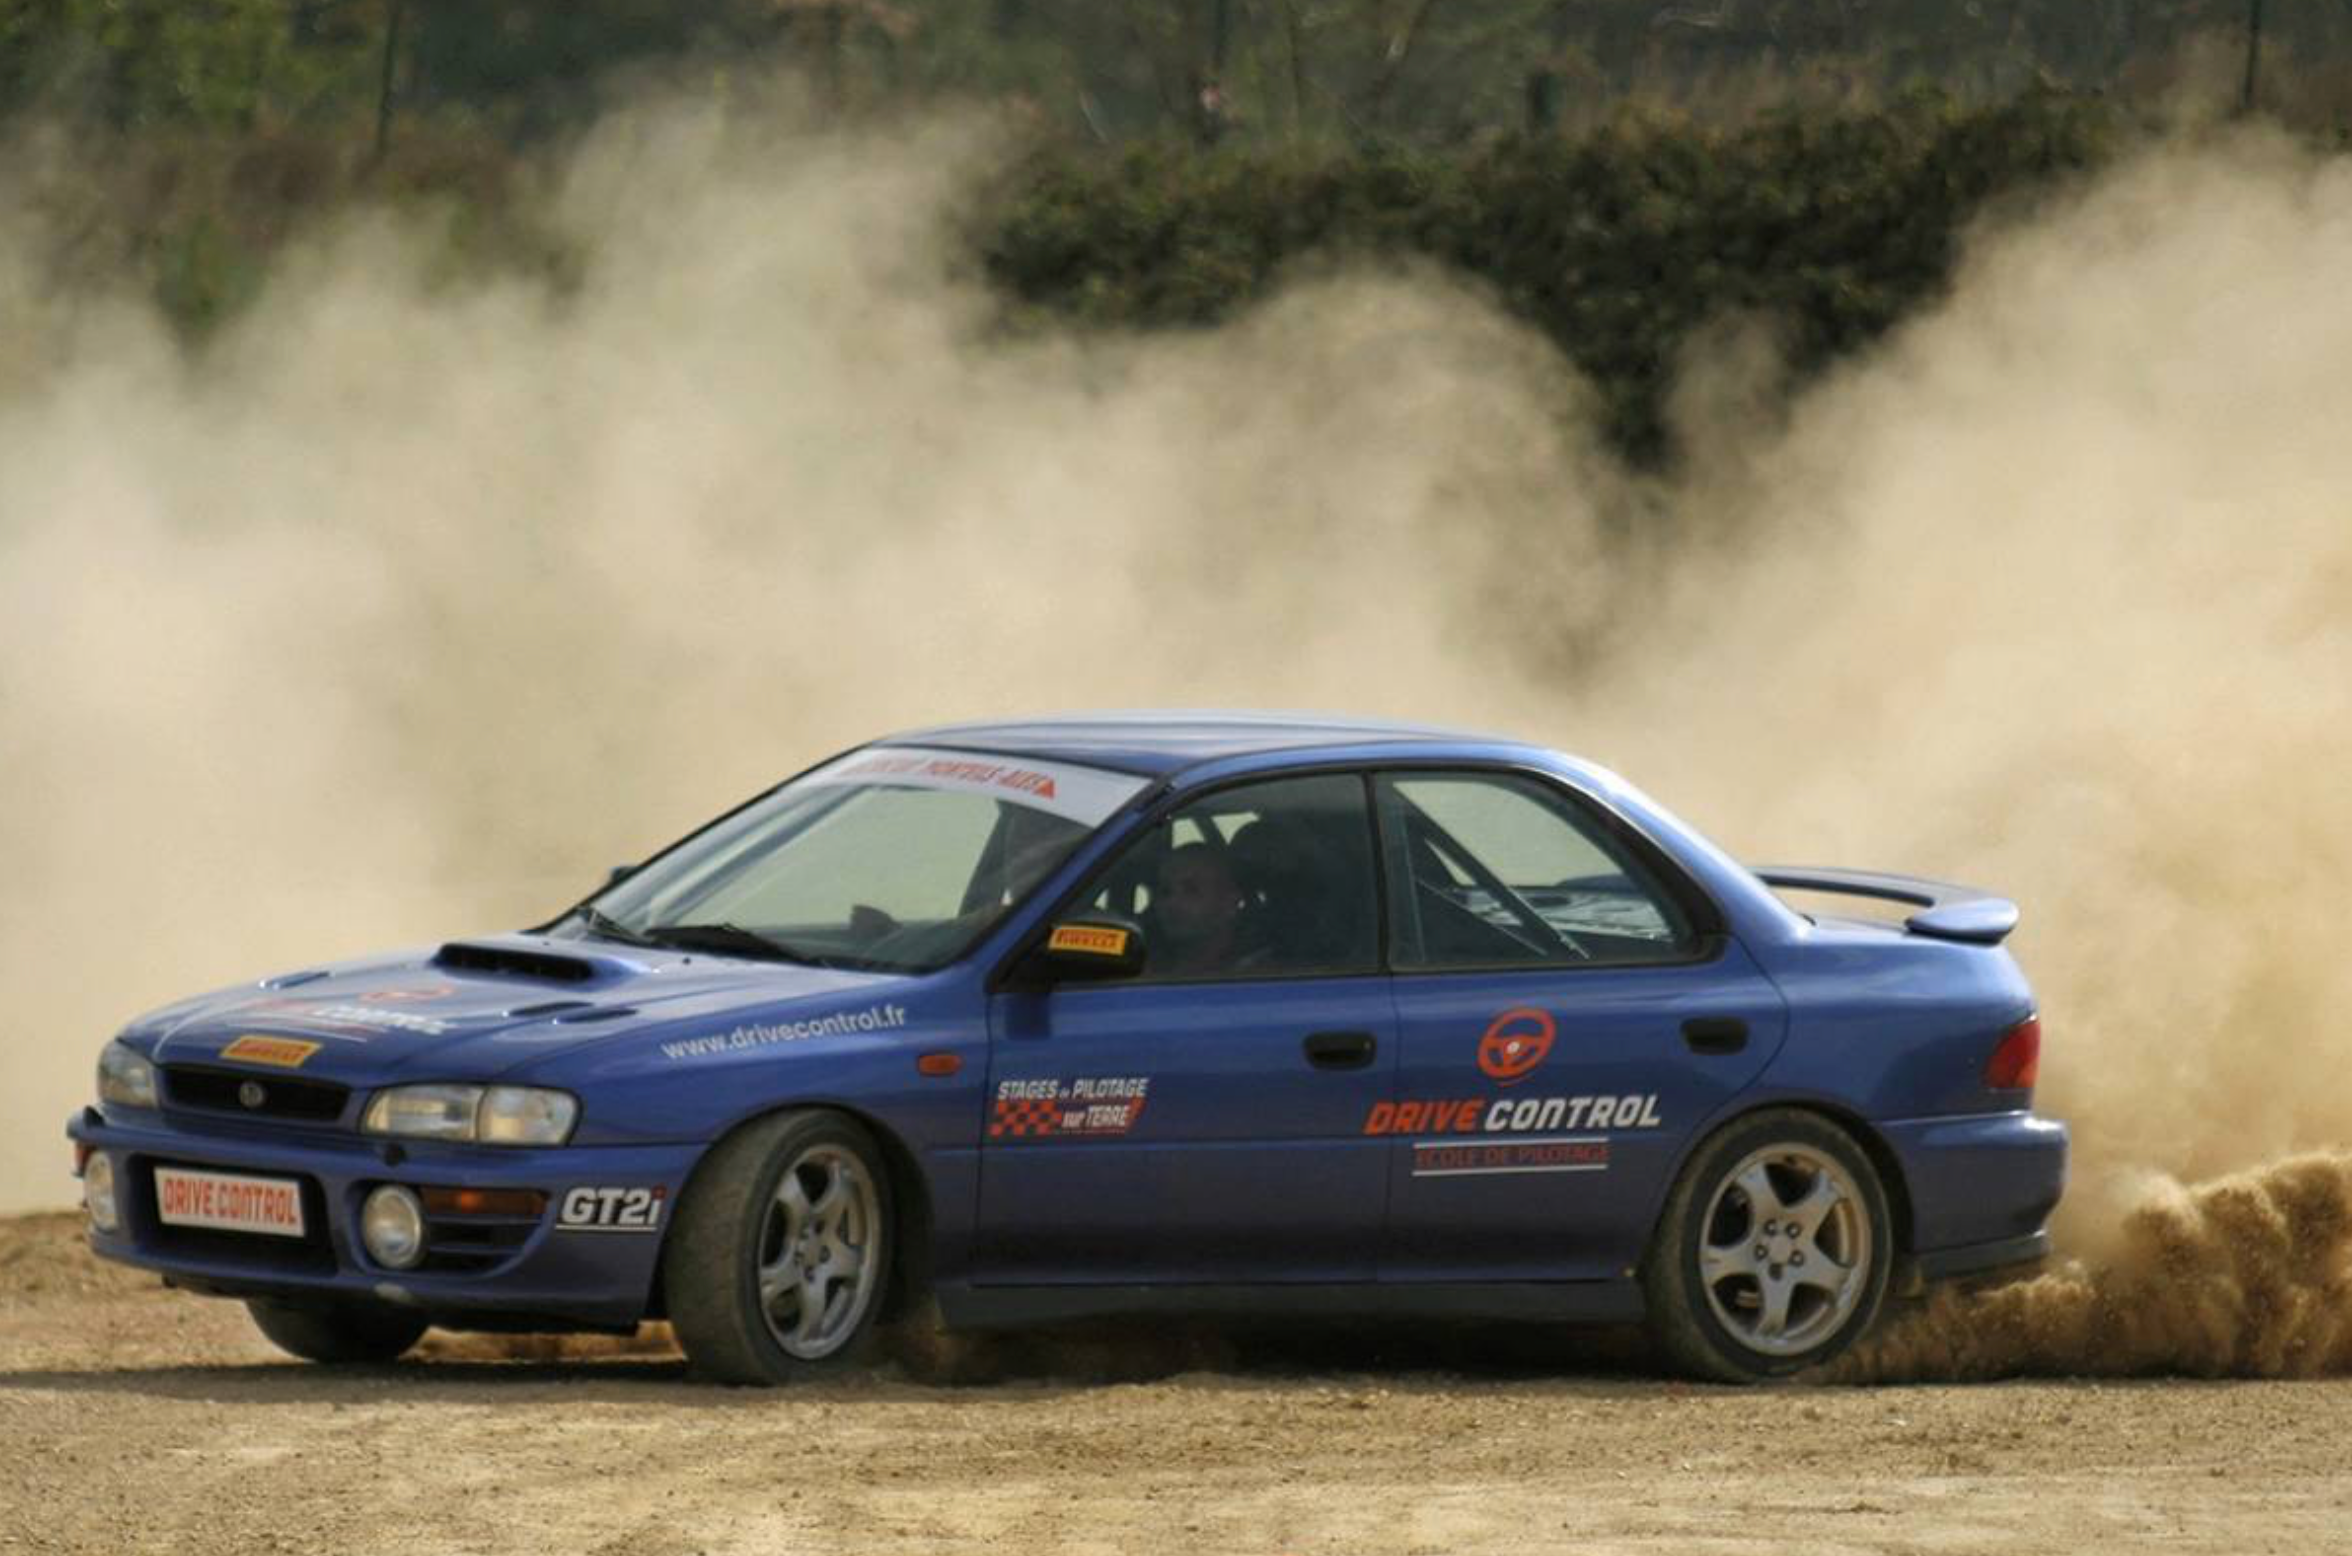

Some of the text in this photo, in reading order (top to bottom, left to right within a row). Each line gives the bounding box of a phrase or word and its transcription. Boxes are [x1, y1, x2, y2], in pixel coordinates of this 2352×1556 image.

[661, 1004, 905, 1059] www.drivecontrol.fr
[998, 1079, 1059, 1100] STAGES
[1072, 1077, 1149, 1099] PILOTAGE
[1364, 1094, 1662, 1135] DRIVE CONTROL
[163, 1177, 297, 1226] DRIVE CONTROL
[562, 1182, 667, 1225] GT2i
